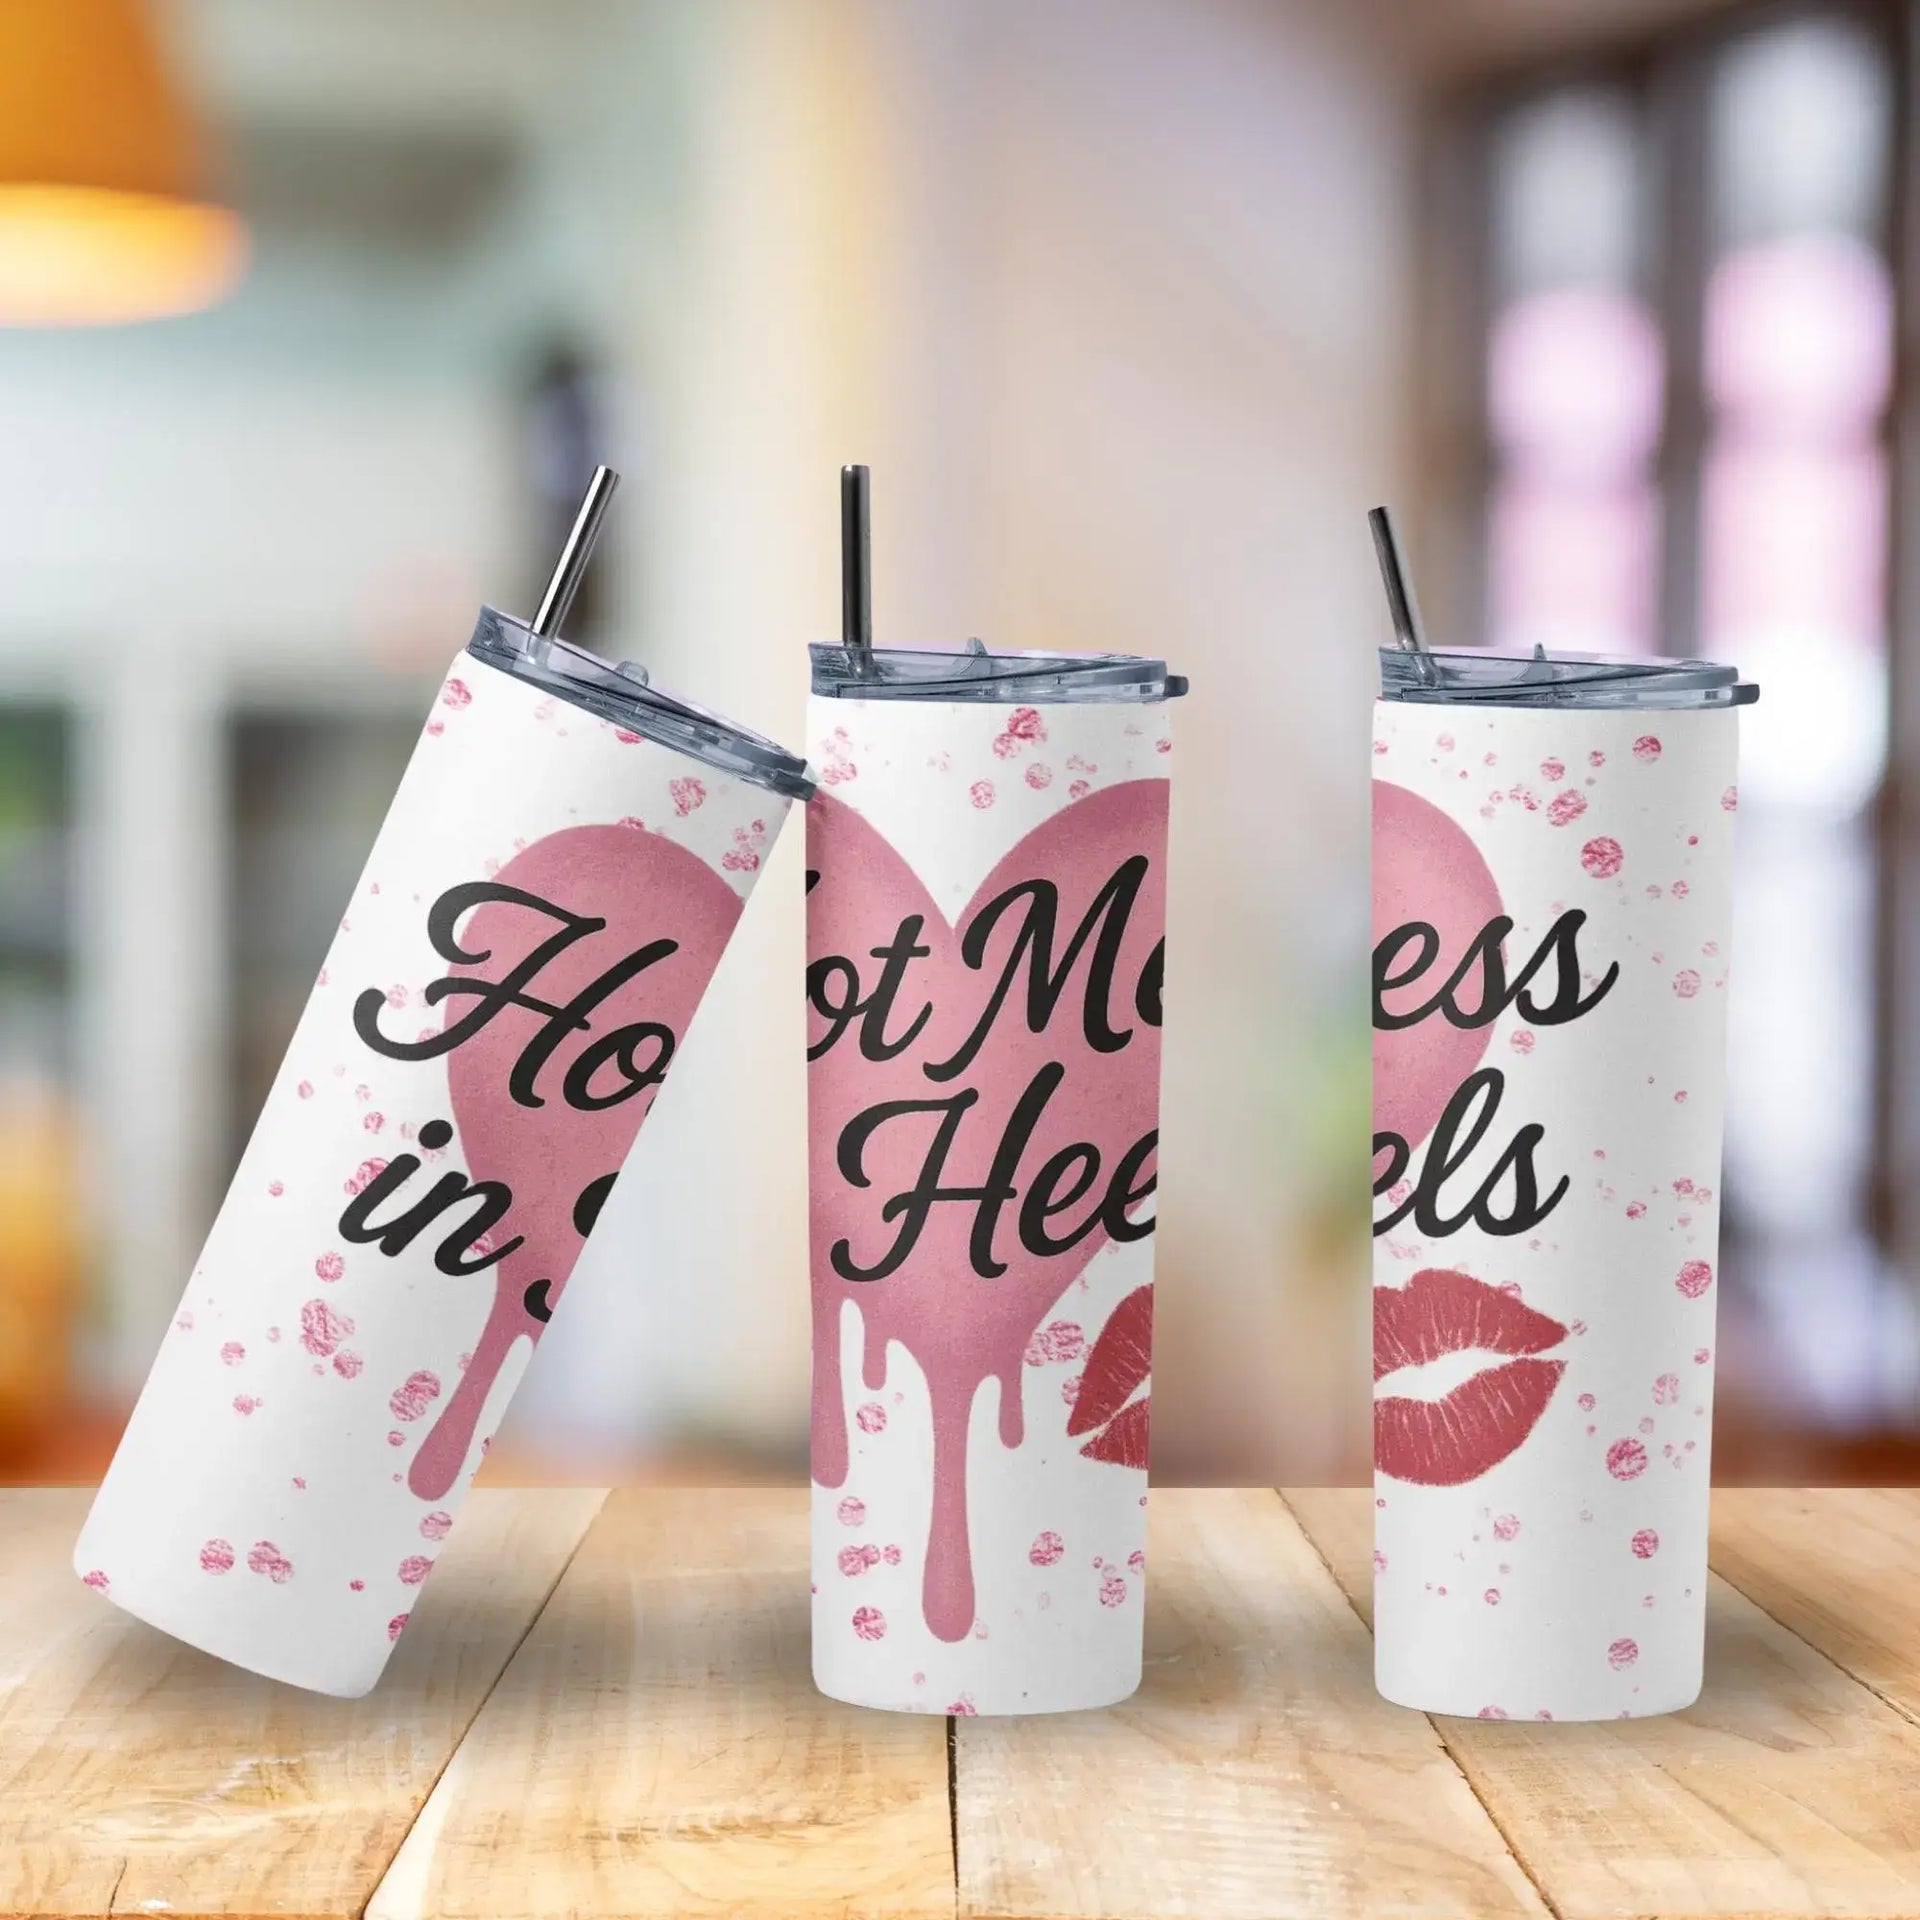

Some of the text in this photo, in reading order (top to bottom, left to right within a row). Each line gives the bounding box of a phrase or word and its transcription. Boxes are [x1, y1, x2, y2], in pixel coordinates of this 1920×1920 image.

[353, 881, 679, 1114] Ho
[806, 869, 933, 1062] ot
[1371, 909, 1620, 1030] ess
[338, 1119, 526, 1277] in
